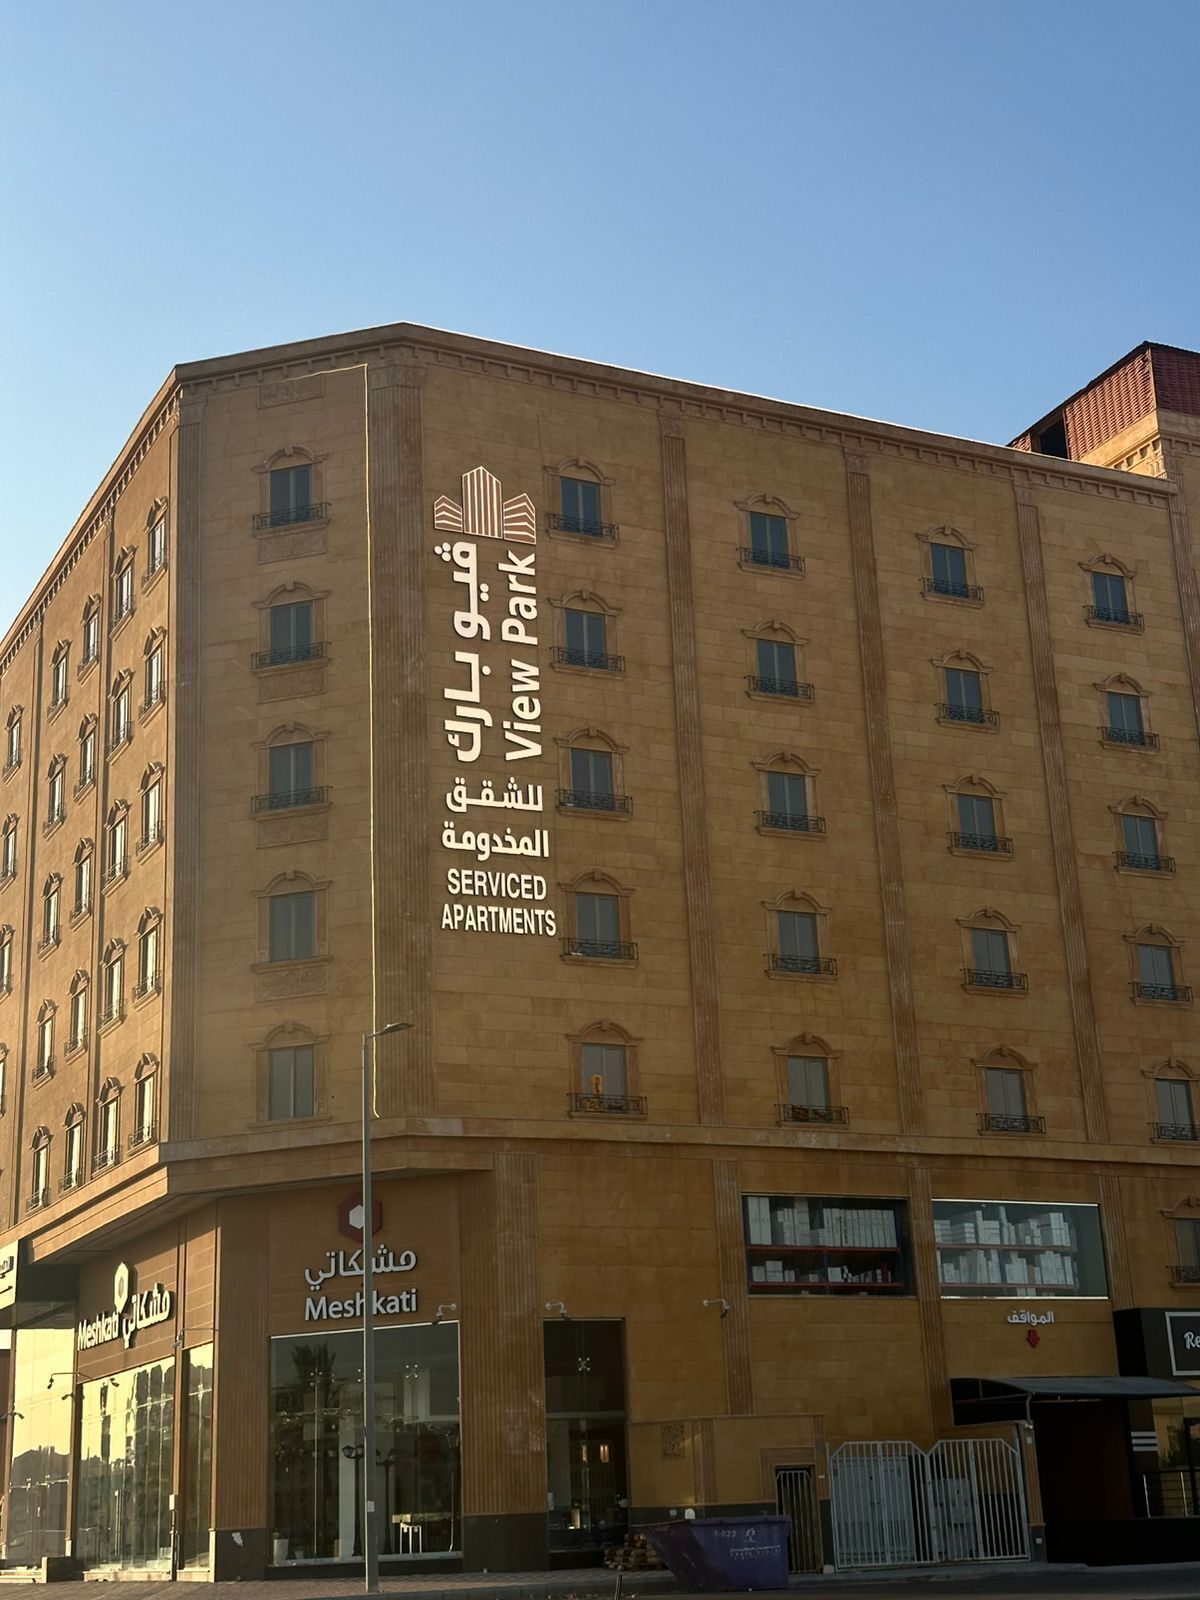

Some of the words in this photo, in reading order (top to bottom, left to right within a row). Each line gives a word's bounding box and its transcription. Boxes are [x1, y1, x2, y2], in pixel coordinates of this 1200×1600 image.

[498, 550, 538, 645] Park
[444, 651, 493, 763] بارك
[503, 659, 542, 761] View
[446, 777, 543, 812] للشقق
[442, 820, 549, 861] المخدومة
[447, 868, 547, 900] SERVICED
[441, 903, 557, 936] APARTMENTS
[304, 1244, 417, 1291] مشكاتي
[122, 1282, 170, 1350] مشكاتي
[304, 1287, 417, 1321] Meshkati
[1007, 1310, 1055, 1326] المواقف
[77, 1309, 120, 1351] Meshkati
